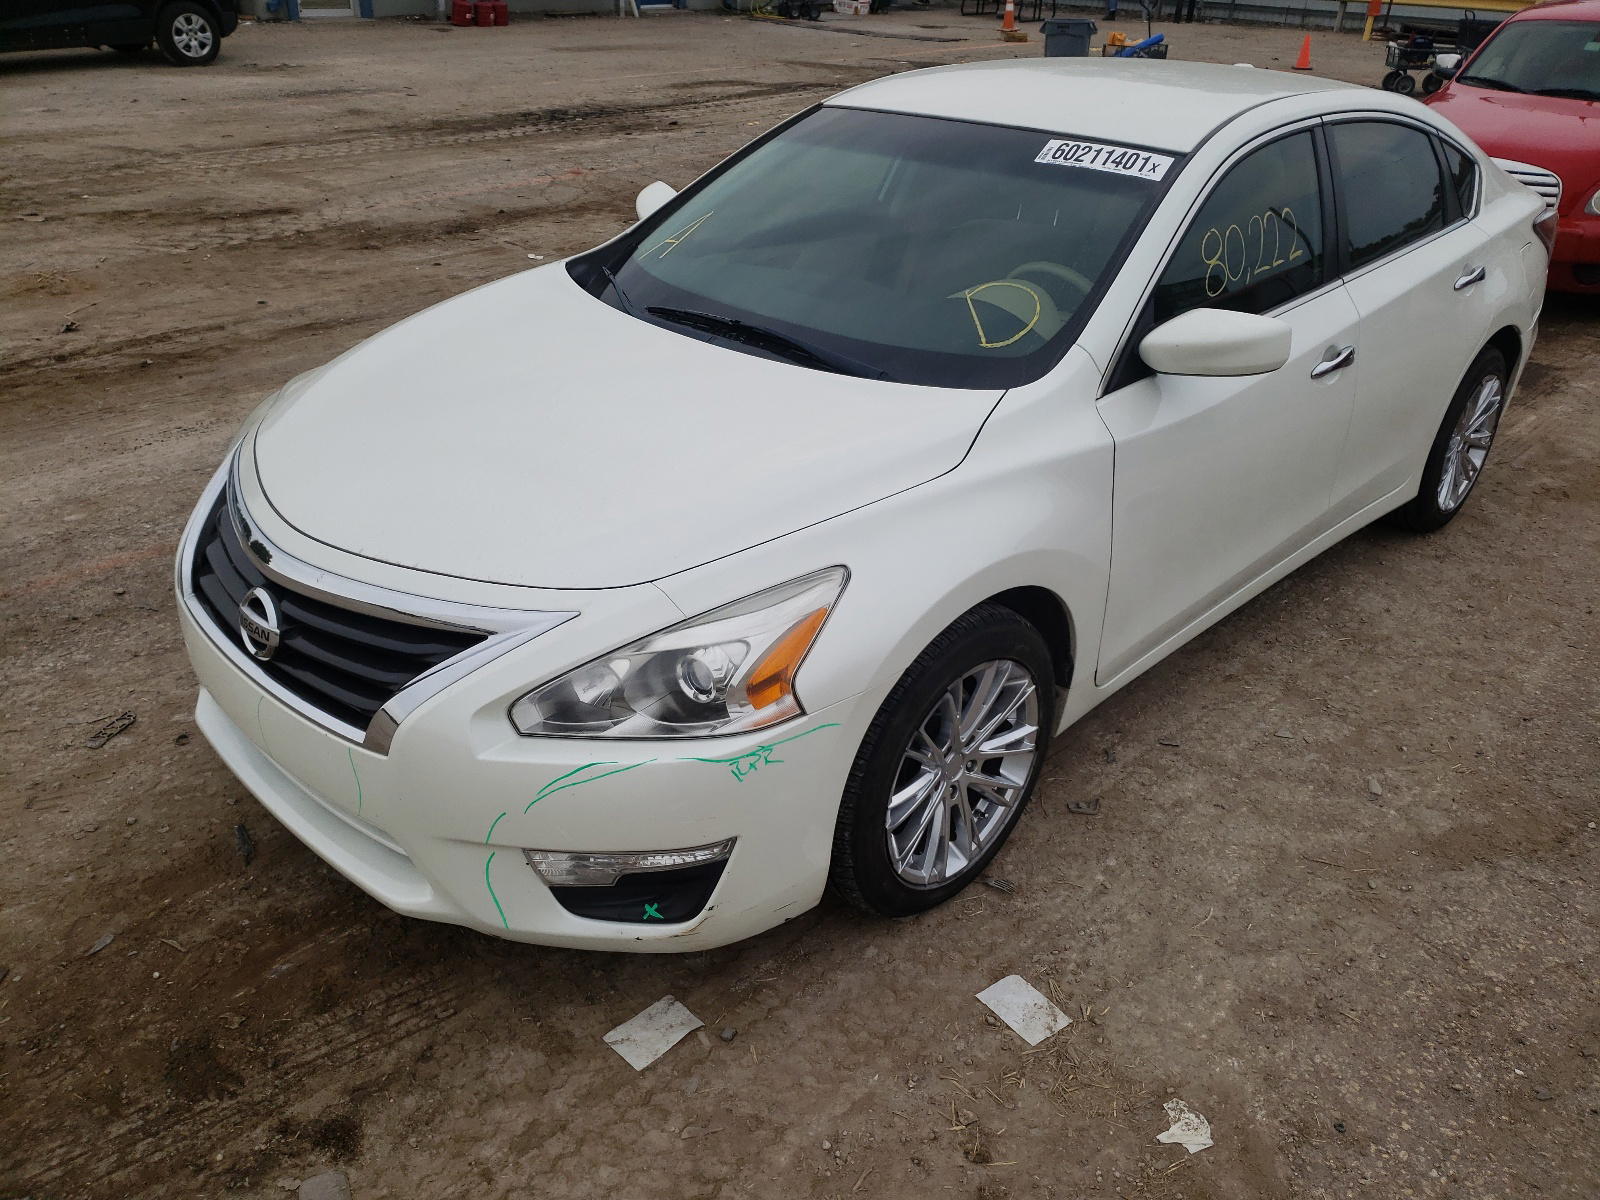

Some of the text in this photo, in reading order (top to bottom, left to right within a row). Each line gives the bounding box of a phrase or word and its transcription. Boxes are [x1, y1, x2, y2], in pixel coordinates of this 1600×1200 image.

[1201, 207, 1303, 297] 80,222
[965, 281, 1040, 348] D
[240, 612, 270, 642] SSAN
